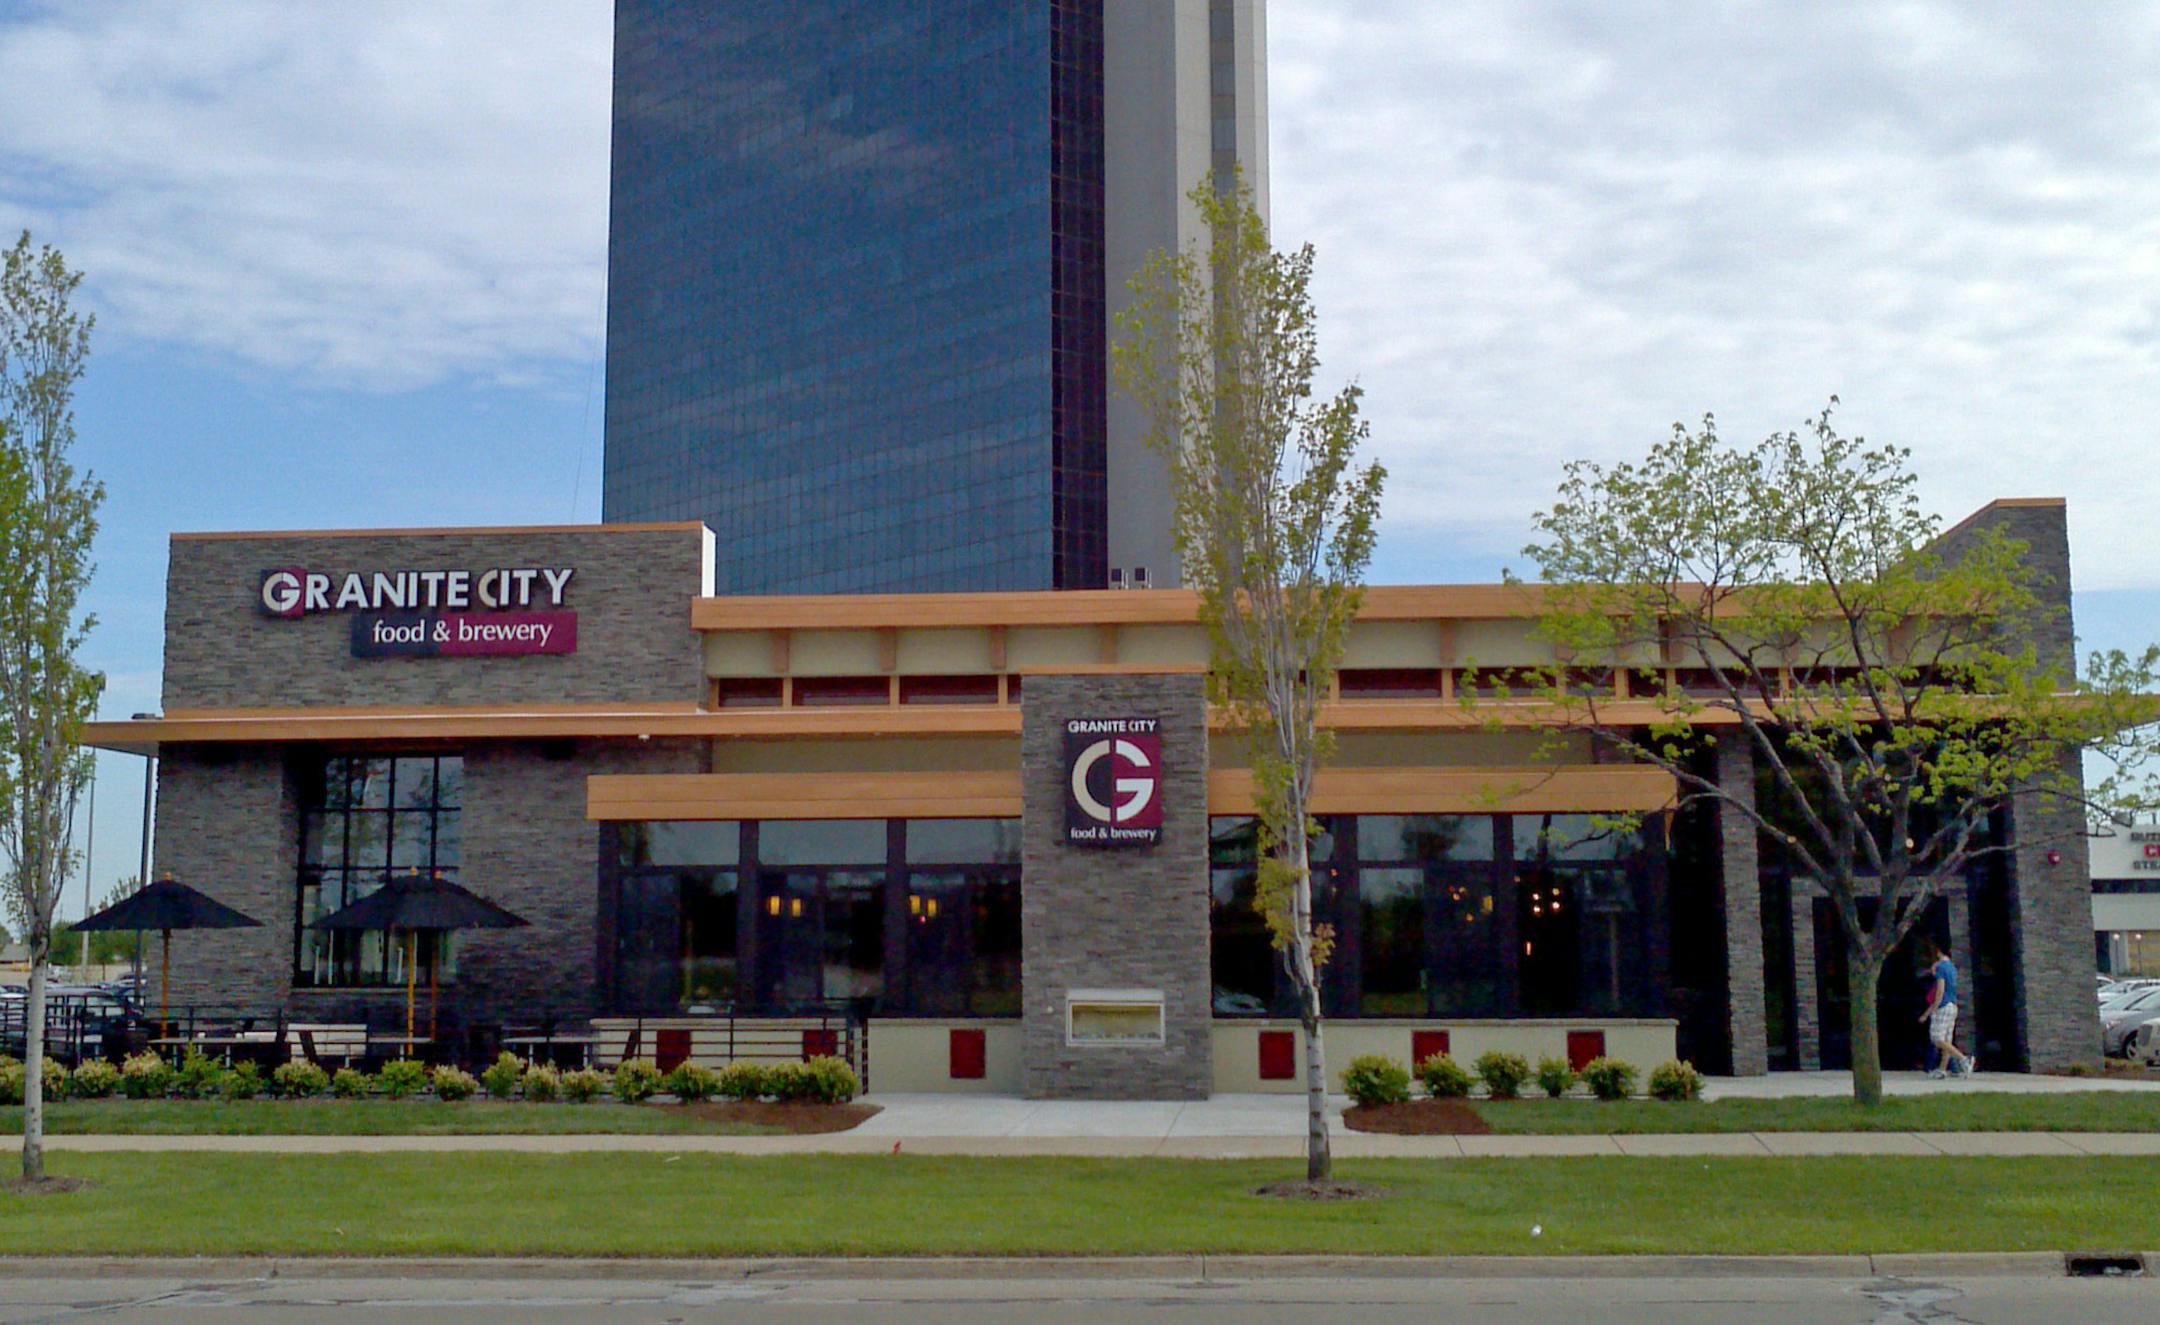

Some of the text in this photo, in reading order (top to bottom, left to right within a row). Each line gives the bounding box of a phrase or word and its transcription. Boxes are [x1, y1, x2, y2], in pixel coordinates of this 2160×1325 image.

[262, 568, 574, 612] GRANITE CITY
[373, 618, 553, 647] food & brewery
[1068, 720, 1156, 733] GRANITE CITY
[1072, 739, 1154, 822] G
[1071, 826, 1157, 841] food & brewery
